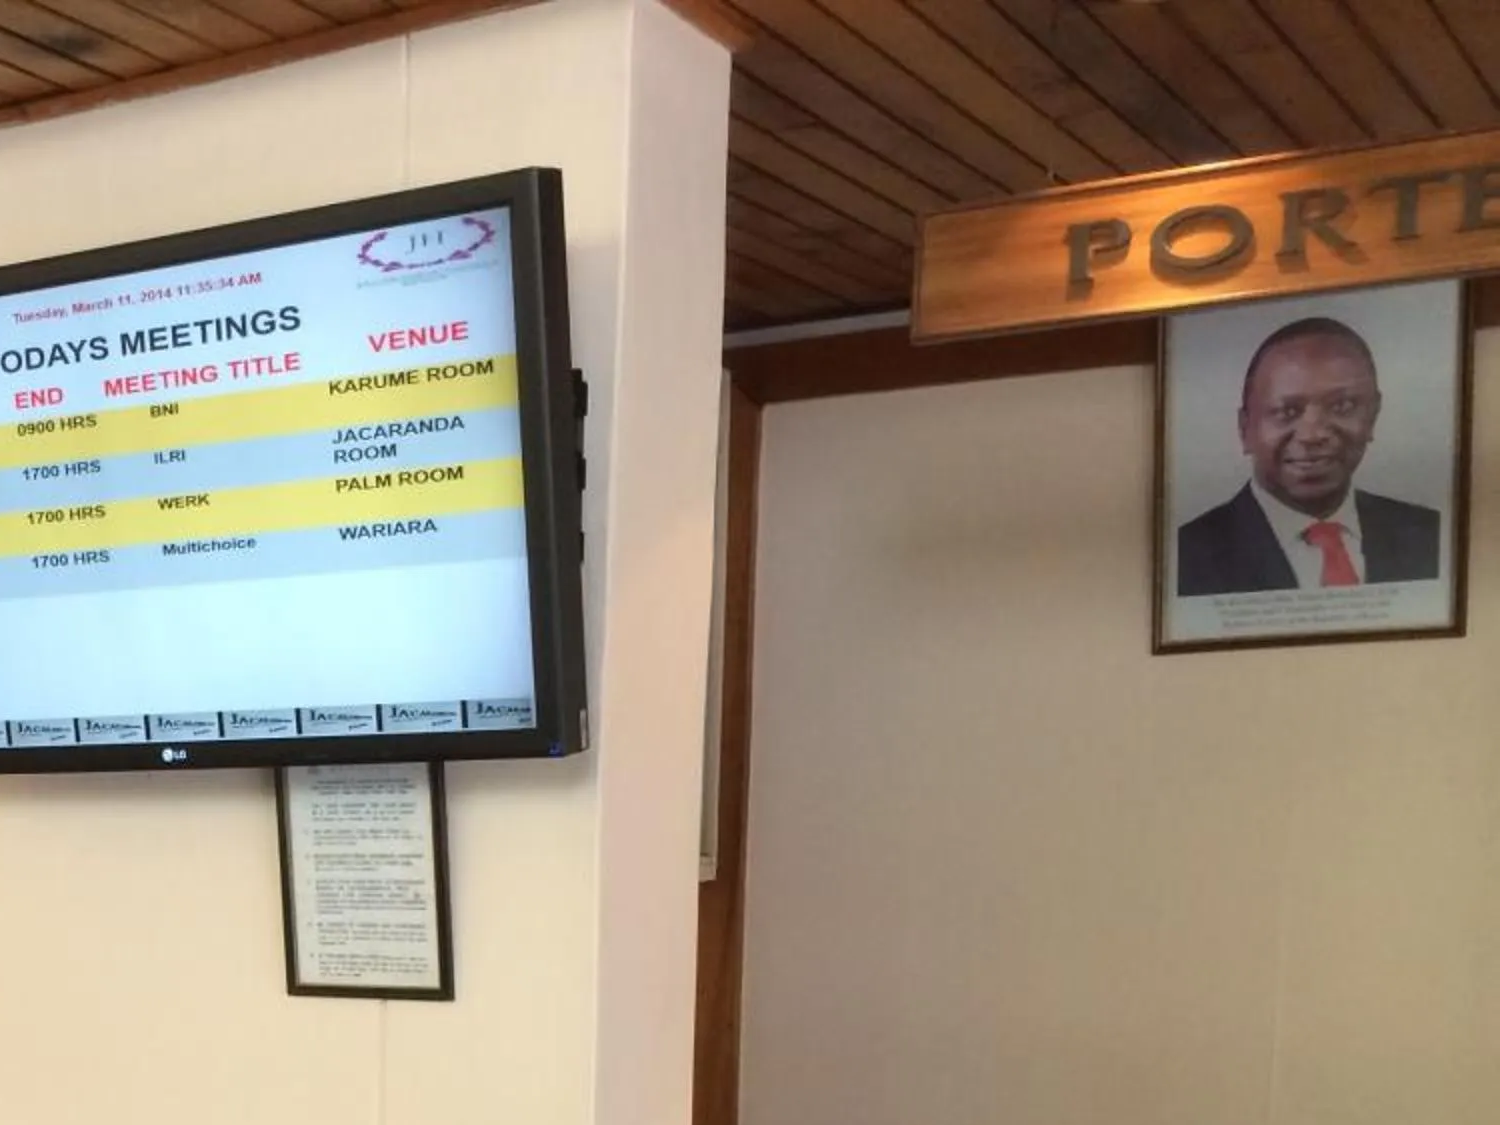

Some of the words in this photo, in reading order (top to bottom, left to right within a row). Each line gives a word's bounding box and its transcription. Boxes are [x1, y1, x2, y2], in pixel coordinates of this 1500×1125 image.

[72, 297, 113, 313] March
[141, 287, 172, 302] 2014
[238, 271, 262, 286] AM
[120, 305, 302, 357] MEETINGS
[368, 321, 470, 352] VENUE
[104, 365, 219, 397] MEETING
[227, 352, 301, 380] TITLE
[328, 369, 420, 396] KARUME
[426, 359, 495, 383] ROOM
[14, 387, 65, 410] END
[149, 403, 180, 418] BNI
[17, 418, 56, 437] 0900
[60, 413, 98, 432] HRS
[332, 415, 466, 445] JACARANDA
[153, 449, 186, 465] ILRI
[333, 443, 398, 465] ROOM
[21, 465, 59, 481] 1700
[64, 459, 102, 477] HRS
[335, 473, 392, 493] PALM
[398, 465, 465, 487] ROOM
[157, 493, 211, 511] WERK
[27, 508, 65, 525] 1700
[69, 504, 107, 521] HRS
[338, 518, 438, 541] WARIARA
[162, 537, 258, 557] Multichoice
[31, 553, 69, 569] 1700
[73, 549, 111, 566] HRS
